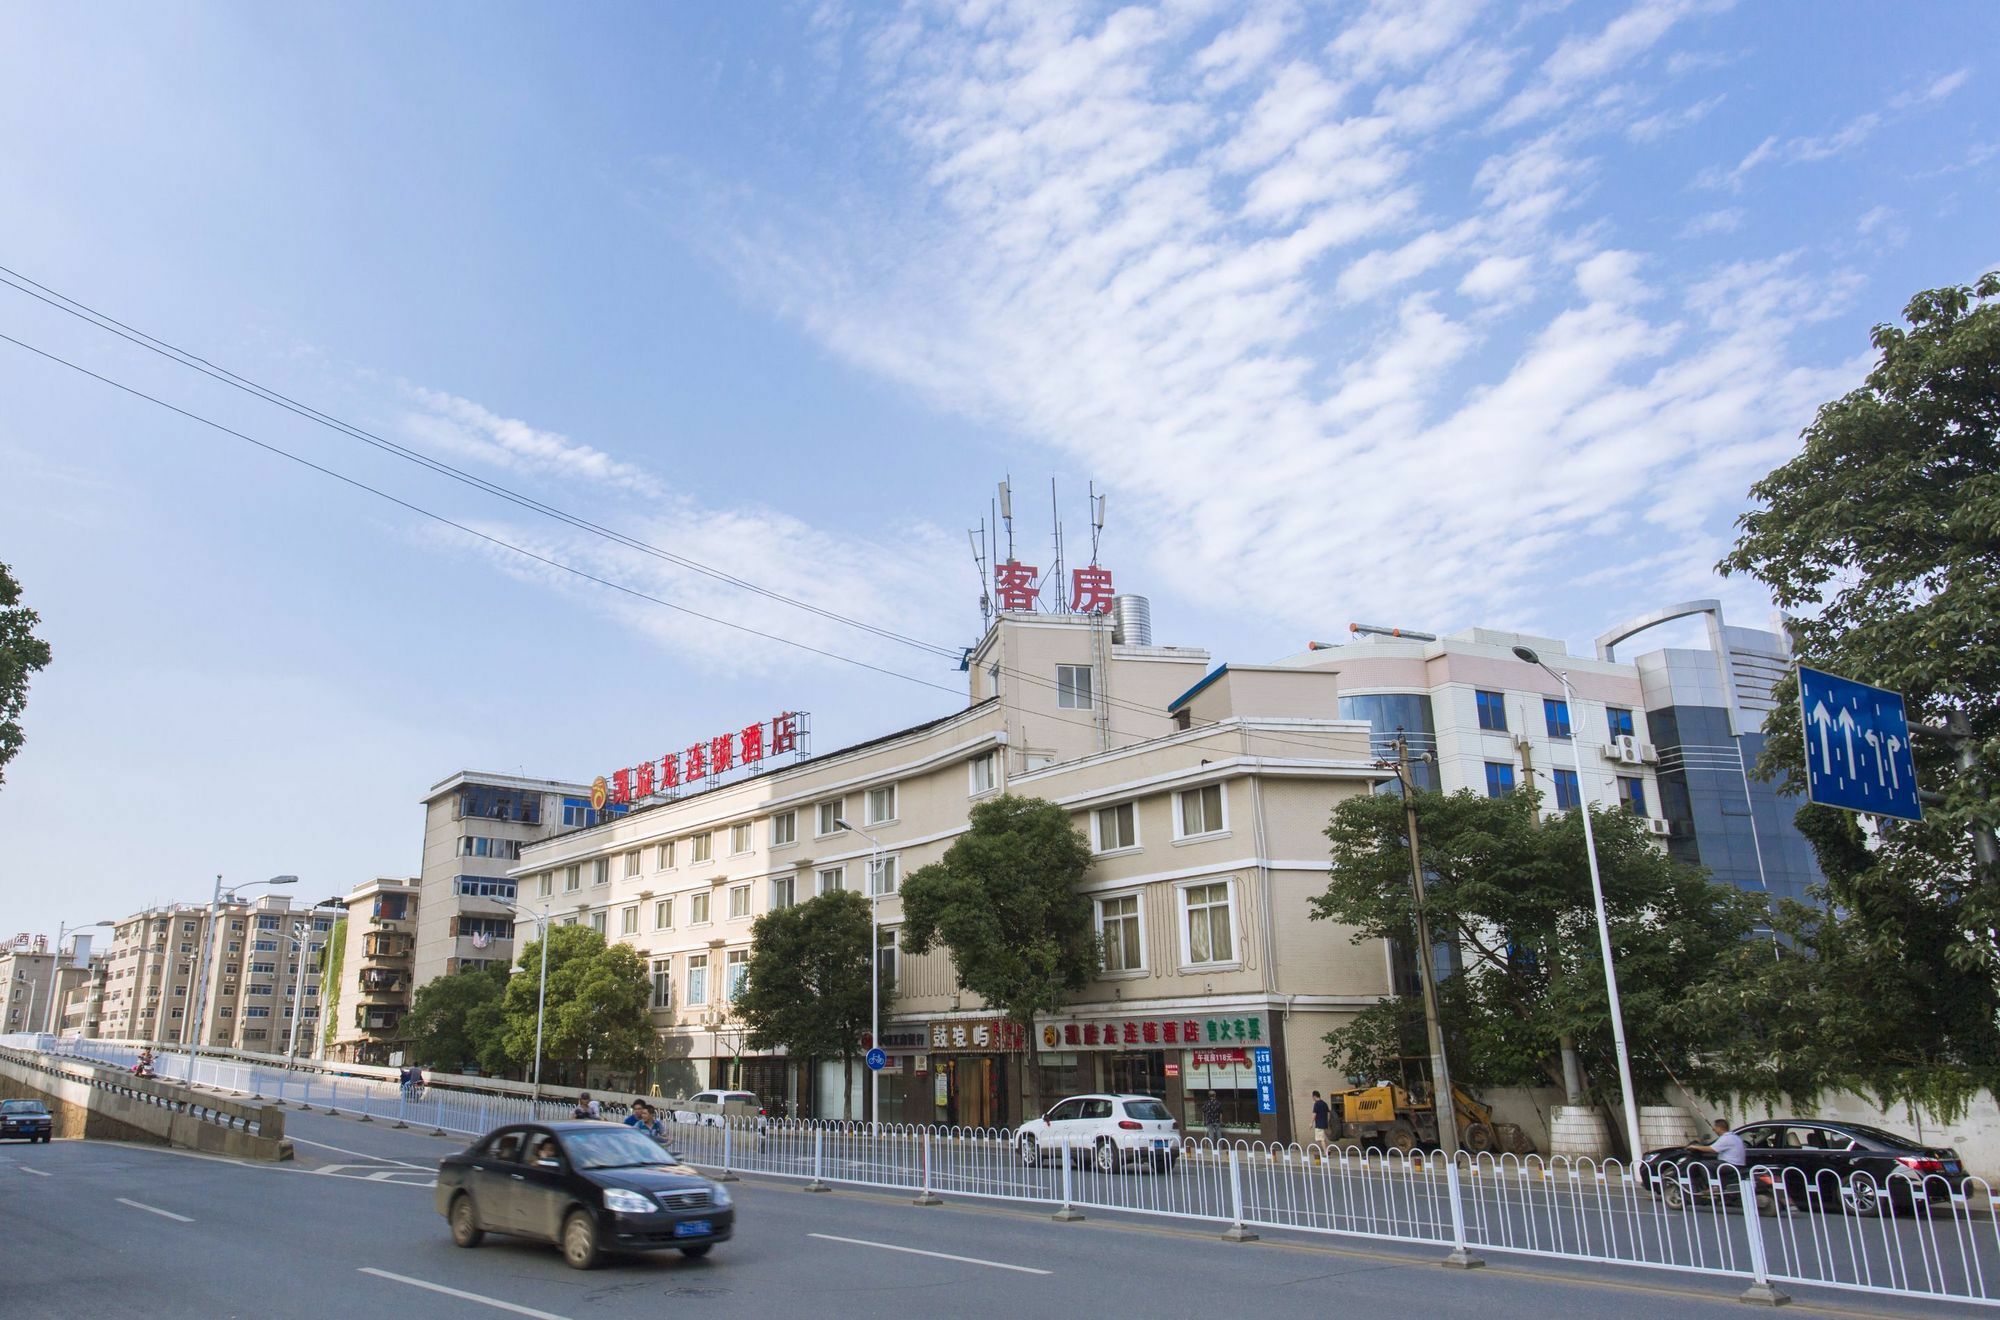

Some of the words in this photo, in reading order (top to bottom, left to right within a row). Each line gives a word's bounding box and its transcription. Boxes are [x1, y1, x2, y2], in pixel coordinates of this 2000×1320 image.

[995, 561, 1115, 614] 客房
[612, 711, 797, 804] 凯旋龙连锁酒店
[933, 1024, 990, 1048] 鼓浪屿
[1064, 1019, 1200, 1045] 凯旋龙连锁酒店
[1207, 1017, 1261, 1041] 售火车票
